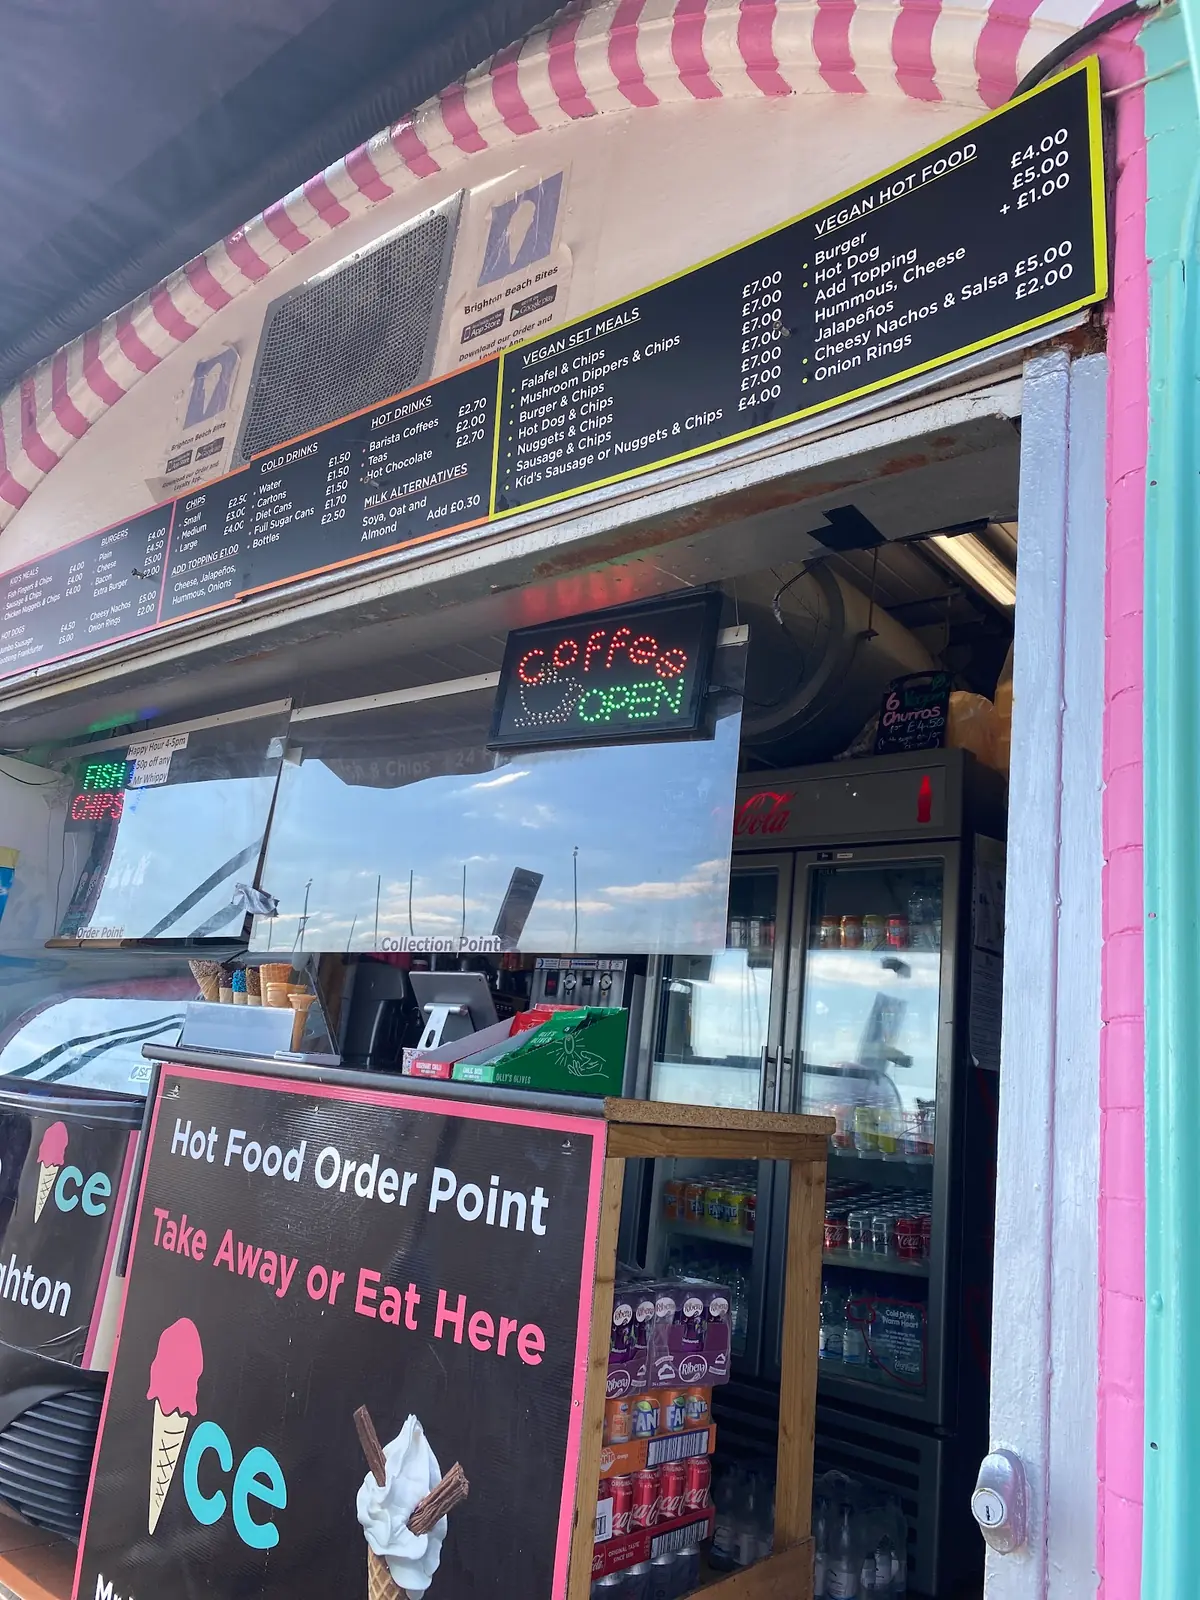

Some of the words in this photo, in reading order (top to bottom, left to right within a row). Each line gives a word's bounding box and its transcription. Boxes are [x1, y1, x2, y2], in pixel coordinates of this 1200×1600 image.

[1011, 128, 1068, 169] £4.00
[1012, 151, 1069, 190] £5.00
[815, 196, 874, 235] VEGAN
[879, 177, 916, 205] HOT
[922, 144, 977, 183] FOOD
[1017, 173, 1069, 210] £1.00
[815, 231, 867, 266] Burger
[814, 283, 846, 303] Add
[850, 247, 918, 289] Topping
[815, 264, 841, 285] Hot
[847, 246, 880, 272] Dog
[464, 292, 502, 315] Brighton
[505, 279, 532, 297] Beach
[535, 266, 559, 283] Bites
[741, 271, 782, 299] £7.00
[815, 280, 898, 323] Hummous,
[902, 246, 966, 284] Cheese
[1015, 263, 1073, 300] £2.00
[741, 290, 782, 317] £7.00
[814, 331, 870, 362] Cheesy
[876, 302, 938, 337] Nachos
[943, 293, 955, 308] &
[961, 271, 1008, 302] Salsa
[1014, 241, 1072, 278] £5.00
[497, 334, 511, 344] our
[512, 322, 535, 337] Order
[537, 314, 552, 327] and
[741, 309, 781, 335] £7.00
[814, 301, 893, 342] Jalapeños
[523, 342, 565, 365] VEGAN
[569, 328, 592, 346] SET
[595, 308, 640, 335] MEALS
[741, 328, 782, 354] £7.00
[520, 378, 578, 406] Mushroom
[582, 357, 628, 383] Dippers
[632, 351, 641, 362] &
[644, 335, 680, 357] Chips
[521, 368, 557, 390] Falafel
[561, 364, 569, 373] &
[572, 349, 605, 370] Chips
[741, 346, 781, 373] £7.00
[814, 355, 861, 381] Onion
[866, 334, 912, 367] Rings
[740, 366, 781, 392] £7.00
[458, 398, 487, 417] £2.70
[519, 400, 557, 423] Burger
[560, 396, 568, 406] &
[572, 383, 604, 403] Chips
[738, 385, 781, 412] £4.00
[371, 412, 392, 428] HOT
[395, 396, 432, 418] DRINKS
[456, 413, 485, 433] £2.00
[518, 426, 538, 439] Hot
[542, 415, 565, 432] Dog
[569, 409, 576, 420] &
[580, 396, 613, 416] Chips
[369, 432, 400, 451] Barista
[403, 418, 439, 438] Coffees
[456, 429, 484, 448] £2.70
[517, 431, 564, 455] Nuggets
[568, 426, 576, 436] &
[579, 412, 613, 433] Chips
[261, 457, 284, 473] COLD
[286, 442, 318, 463] DRINKS
[328, 452, 350, 467] £1.50
[368, 452, 388, 466] Teas
[515, 472, 542, 488] Kid's
[546, 454, 594, 479] Sausage
[598, 449, 610, 460] or
[614, 429, 667, 456] Nuggets
[672, 423, 681, 434] &
[685, 408, 723, 430] Chips
[516, 449, 563, 472] Sausage
[566, 443, 574, 454] &
[578, 430, 611, 450] Chips
[327, 466, 349, 481] £1.50
[367, 467, 383, 480] Hot
[386, 450, 433, 474] Chocolate
[259, 480, 282, 494] Water
[326, 480, 348, 495] £1.50
[364, 491, 387, 508] MILK
[390, 463, 468, 499] ALTERNATIVES
[186, 495, 206, 510] CHIPS
[255, 510, 271, 521] Diet
[274, 502, 292, 514] Cans
[257, 491, 286, 507] Cartons
[325, 495, 347, 510] £1.70
[362, 511, 386, 527] Soya,
[389, 504, 405, 518] Oat
[409, 496, 427, 512] and
[427, 506, 447, 521] Add
[451, 495, 480, 513] £0.30
[183, 512, 201, 527] Small
[254, 523, 268, 535] Full
[270, 515, 293, 530] Sugar
[295, 506, 314, 520] Cans
[321, 509, 345, 525] £2.50
[148, 528, 165, 541] £4.00
[182, 524, 207, 539] Medium
[252, 532, 280, 549] Bottles
[361, 522, 397, 542] Almond
[99, 551, 112, 561] Plain
[179, 540, 198, 552] Large
[69, 561, 84, 573] £4.00
[144, 553, 161, 566] £5.00
[171, 563, 186, 575] ADD
[188, 551, 218, 570] TOPPING
[220, 544, 239, 558] £1.00
[67, 573, 83, 585] £4.00
[207, 579, 232, 593] Onions
[137, 603, 154, 617] £2.00
[139, 591, 156, 604] £5.00
[578, 678, 685, 722] OPEN
[886, 692, 900, 711] 6
[883, 706, 940, 726] Churros
[128, 745, 148, 756] Happy
[149, 741, 164, 752] Hour
[83, 762, 126, 790] FISH
[136, 759, 148, 770] 50p
[149, 757, 159, 768] off
[159, 756, 170, 768] any
[133, 776, 142, 785] Mr
[143, 772, 168, 784] Whippy
[71, 792, 125, 820] CHIPS
[77, 928, 99, 938] Order
[101, 927, 124, 938] Point
[381, 936, 452, 952] Collection
[458, 936, 501, 952] Point
[496, 1073, 513, 1081] OLLY'S
[514, 1076, 531, 1084] OLIVES
[171, 1118, 218, 1164] Hot
[224, 1129, 307, 1183] Food
[314, 1146, 418, 1207] Order
[428, 1167, 549, 1236] Point
[152, 1207, 207, 1261] Take
[213, 1228, 299, 1299] Away
[306, 1265, 346, 1305] or
[354, 1267, 421, 1331] Eat
[434, 1289, 546, 1366] Here
[681, 1362, 706, 1375] Ribena
